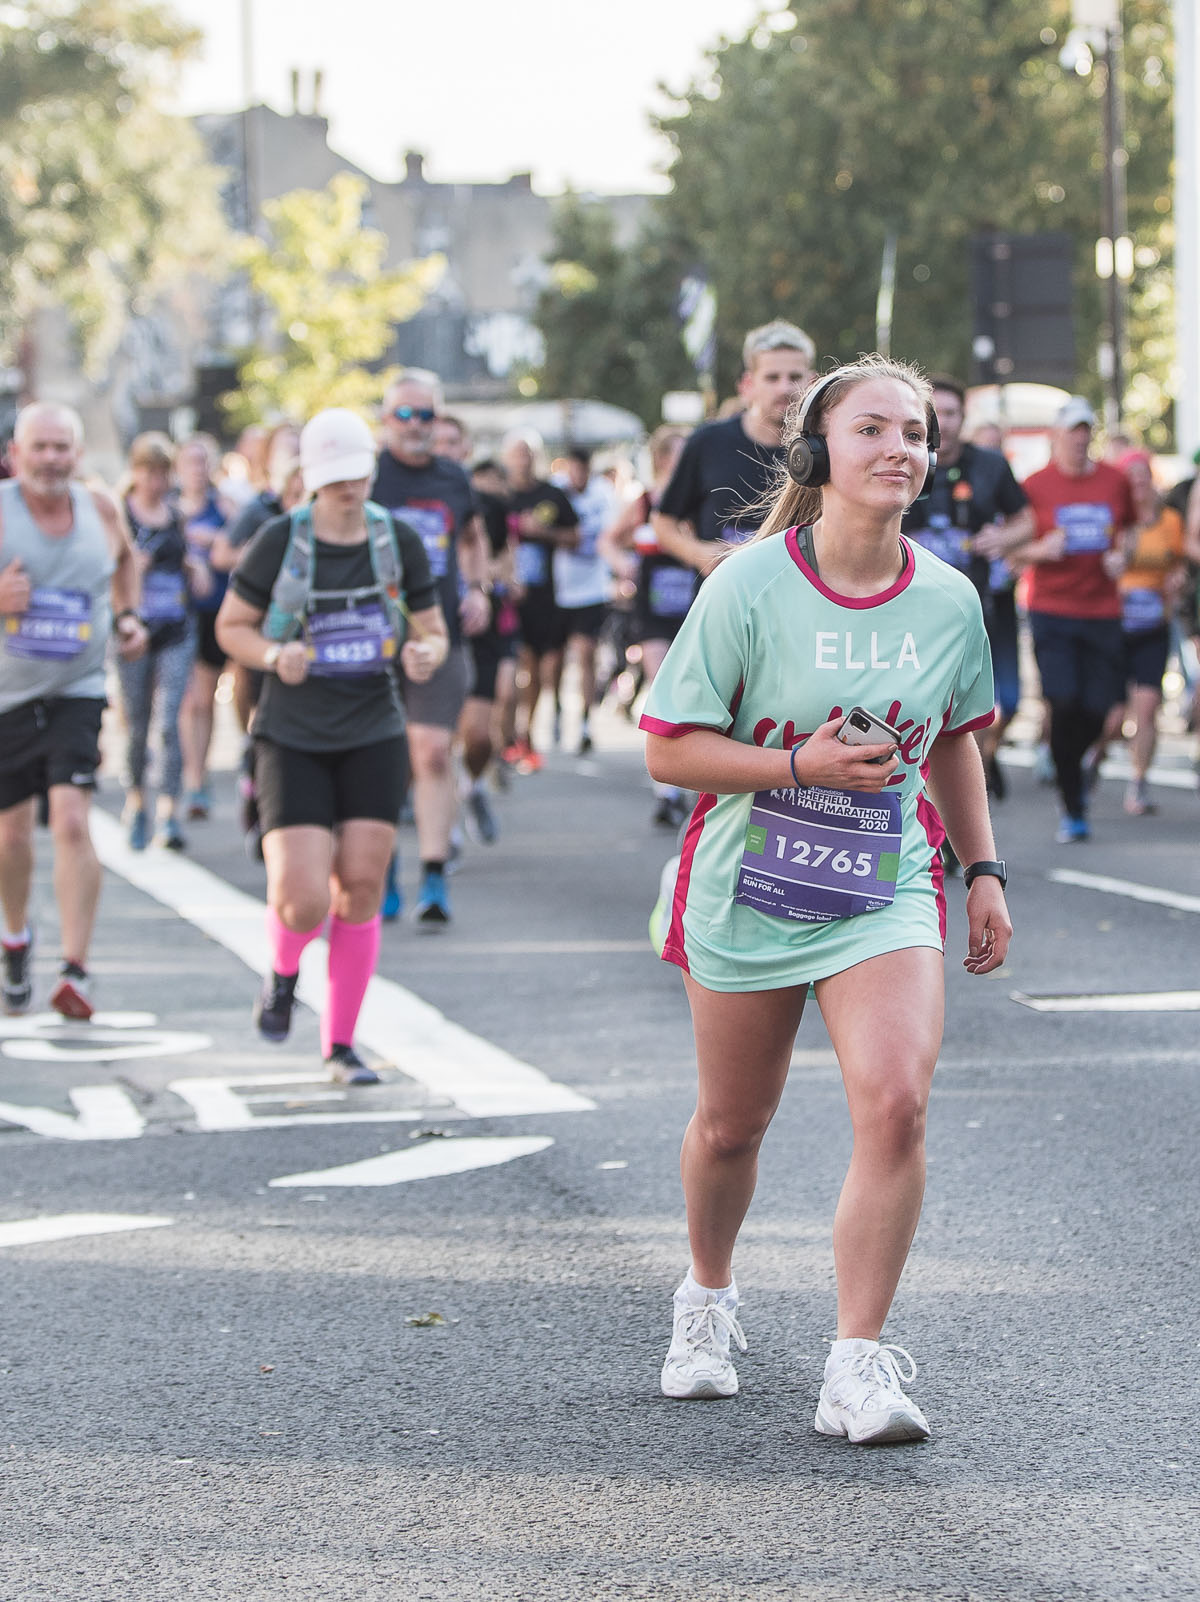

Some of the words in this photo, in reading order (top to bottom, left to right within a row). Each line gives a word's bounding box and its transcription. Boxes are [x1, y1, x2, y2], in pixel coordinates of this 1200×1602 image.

[815, 631, 921, 670] ELLA
[800, 788, 850, 806] SHEFFIELD
[797, 798, 824, 812] HALF
[824, 804, 890, 820] MARATHON
[859, 820, 889, 831] 2020
[776, 835, 873, 877] 12765
[743, 878, 758, 889] RUN
[758, 882, 771, 893] FOR
[772, 886, 786, 896] ALL
[788, 910, 815, 921] Baggage
